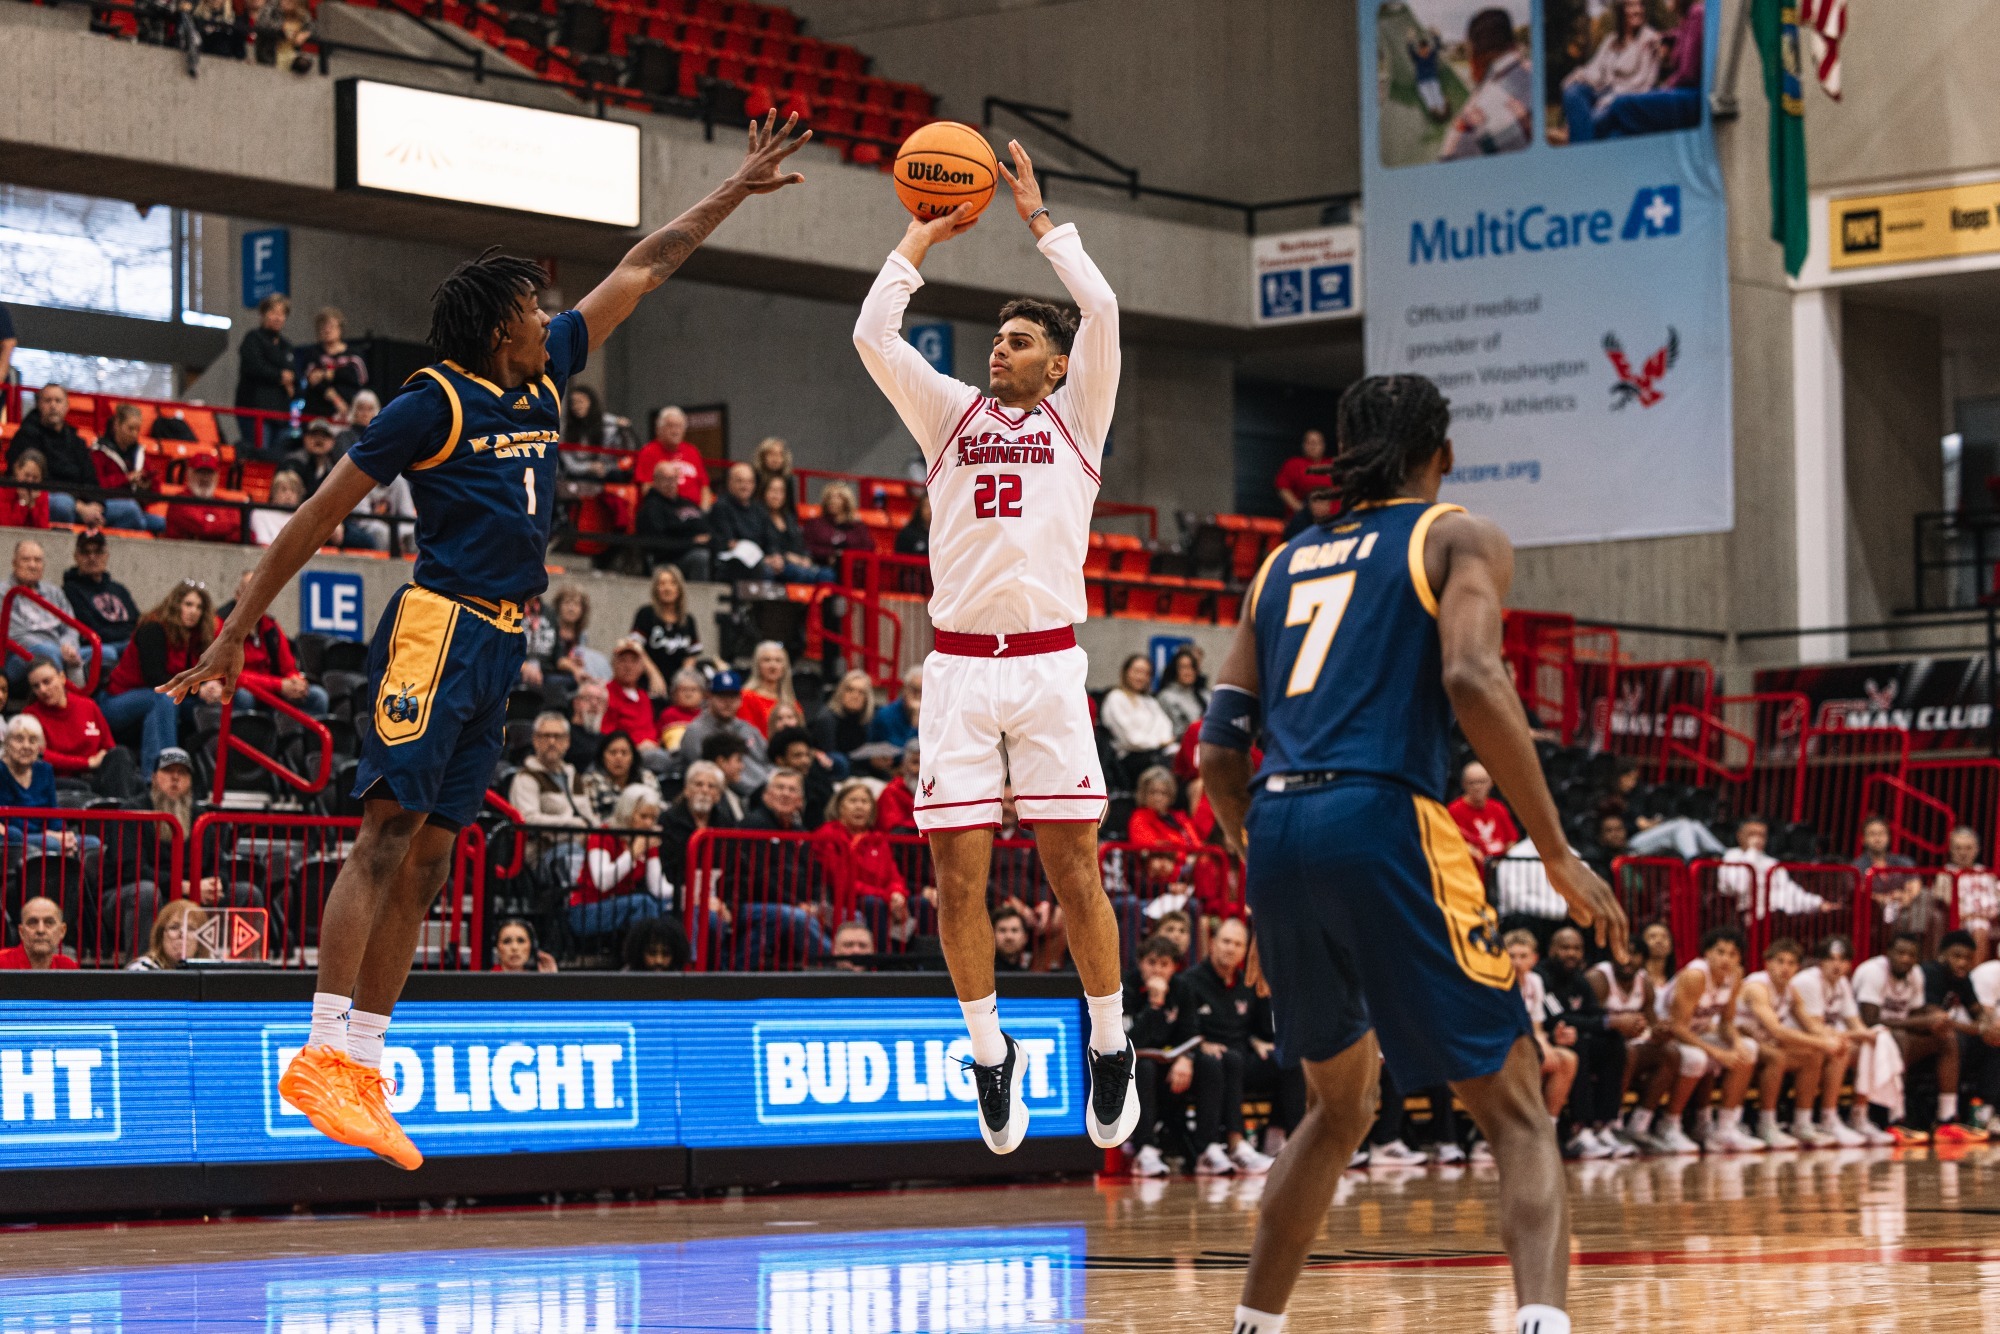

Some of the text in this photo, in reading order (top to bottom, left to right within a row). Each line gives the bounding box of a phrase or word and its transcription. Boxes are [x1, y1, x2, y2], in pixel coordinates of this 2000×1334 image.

[908, 162, 974, 185] Wilson
[254, 237, 274, 272] F
[1409, 206, 1613, 265] MultiCare
[1405, 294, 1542, 327] Official medical
[1406, 336, 1478, 363] provider
[1479, 360, 1588, 384] Washington
[494, 442, 546, 458] CITY
[523, 467, 537, 515] 1
[974, 473, 1023, 518] 22
[311, 582, 358, 632] LE
[1284, 570, 1357, 698] 7
[1916, 703, 1992, 731] CLUB
[433, 1044, 623, 1112] LIGHT
[766, 1038, 1056, 1105] BUD LIGT
